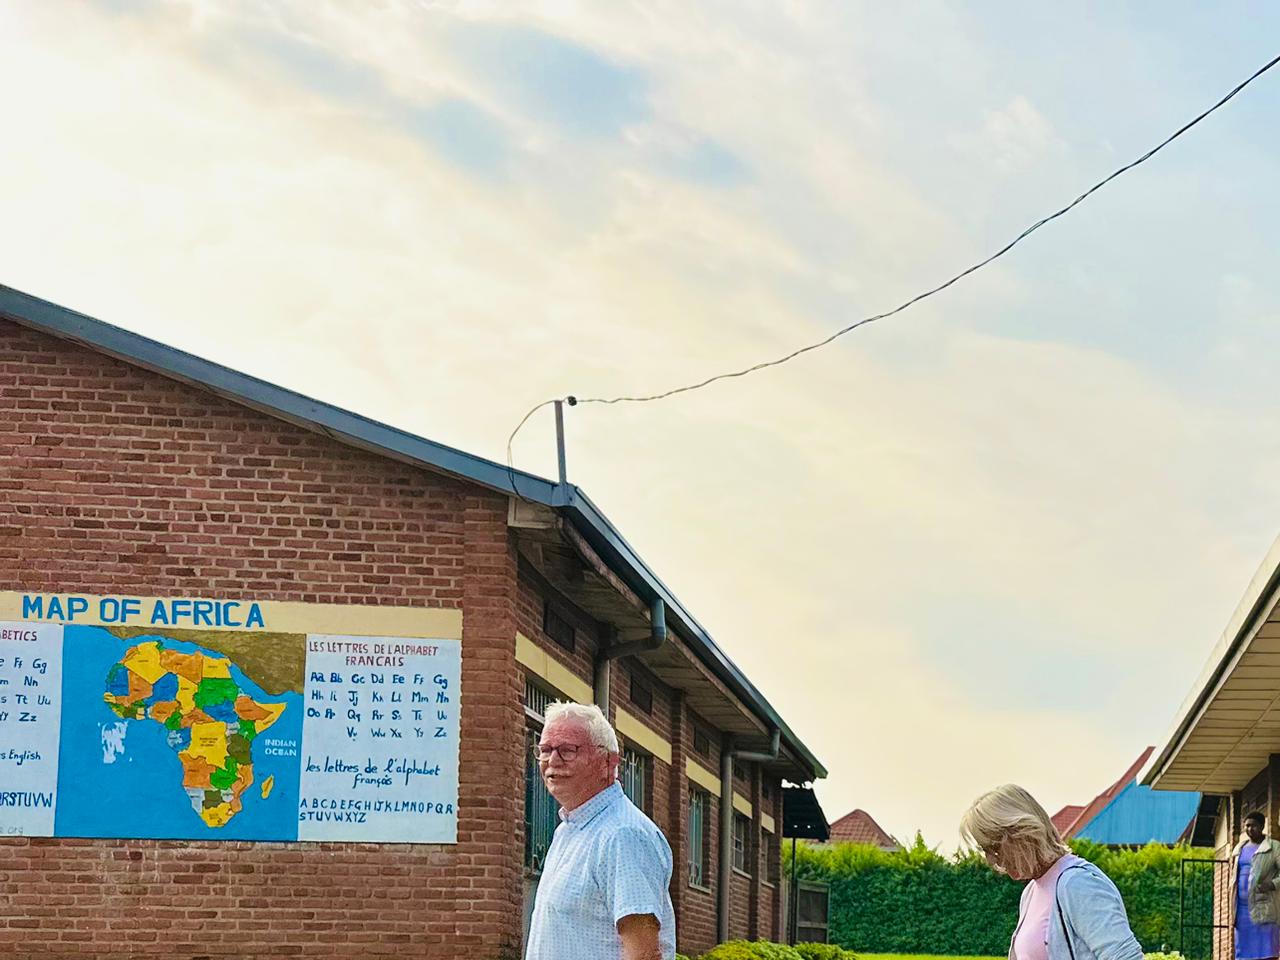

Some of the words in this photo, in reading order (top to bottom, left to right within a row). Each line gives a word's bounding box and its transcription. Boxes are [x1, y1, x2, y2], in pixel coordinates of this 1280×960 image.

[23, 595, 88, 620] MAP
[100, 598, 140, 622] OF
[151, 600, 264, 627] AFRICA
[0, 630, 37, 641] BETICS
[309, 642, 324, 652] LES
[327, 642, 368, 654] LETTRES
[374, 644, 385, 654] DE
[33, 658, 47, 674] Gg
[24, 676, 38, 686] Nn
[371, 674, 384, 684] Dd
[393, 675, 404, 684] Ee
[15, 694, 28, 704] Tt
[38, 695, 50, 705] Uu
[312, 690, 323, 700] Hh
[348, 691, 358, 706] Jj
[412, 692, 429, 703] Mm
[19, 712, 37, 721] Zz
[348, 710, 360, 722] Qq
[265, 739, 296, 748] INDIAN
[9, 749, 41, 766] English
[265, 748, 296, 756] OCEAN
[364, 758, 378, 773] de
